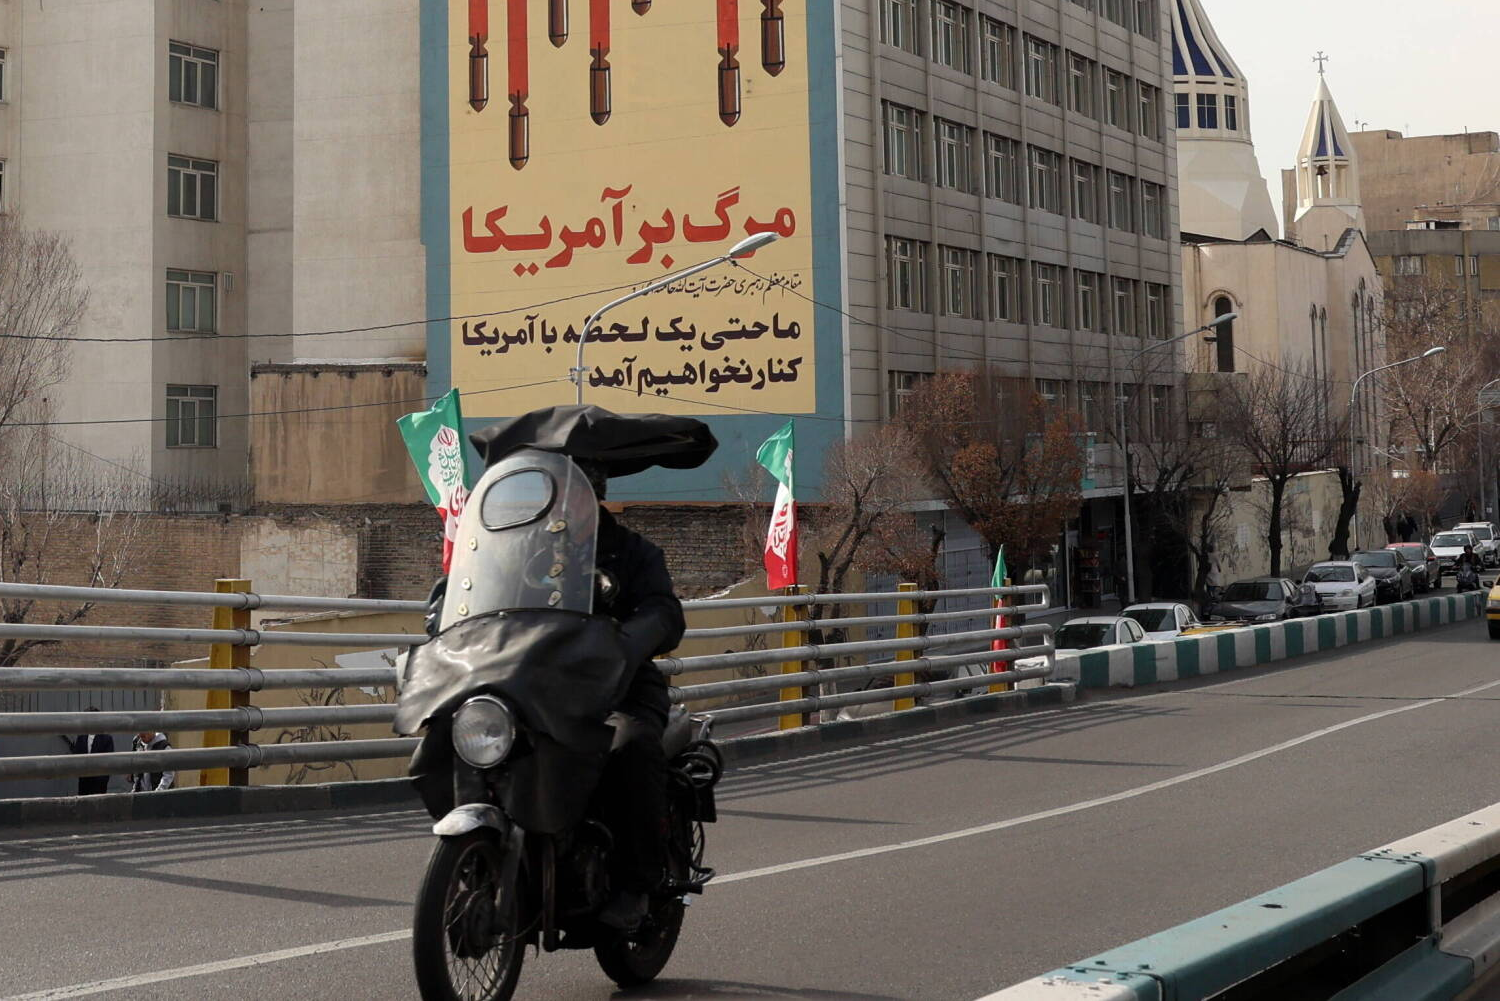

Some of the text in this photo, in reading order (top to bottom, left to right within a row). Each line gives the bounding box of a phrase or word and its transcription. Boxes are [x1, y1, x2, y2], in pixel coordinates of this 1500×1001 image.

[462, 183, 796, 278] مرگ بر آمریکا
[704, 276, 736, 297] حضرت
[734, 278, 765, 296] رهبری
[462, 312, 801, 356] ما حتی یک لحظه با آمریکا
[588, 355, 803, 397] کنار نخواهیم آمد
